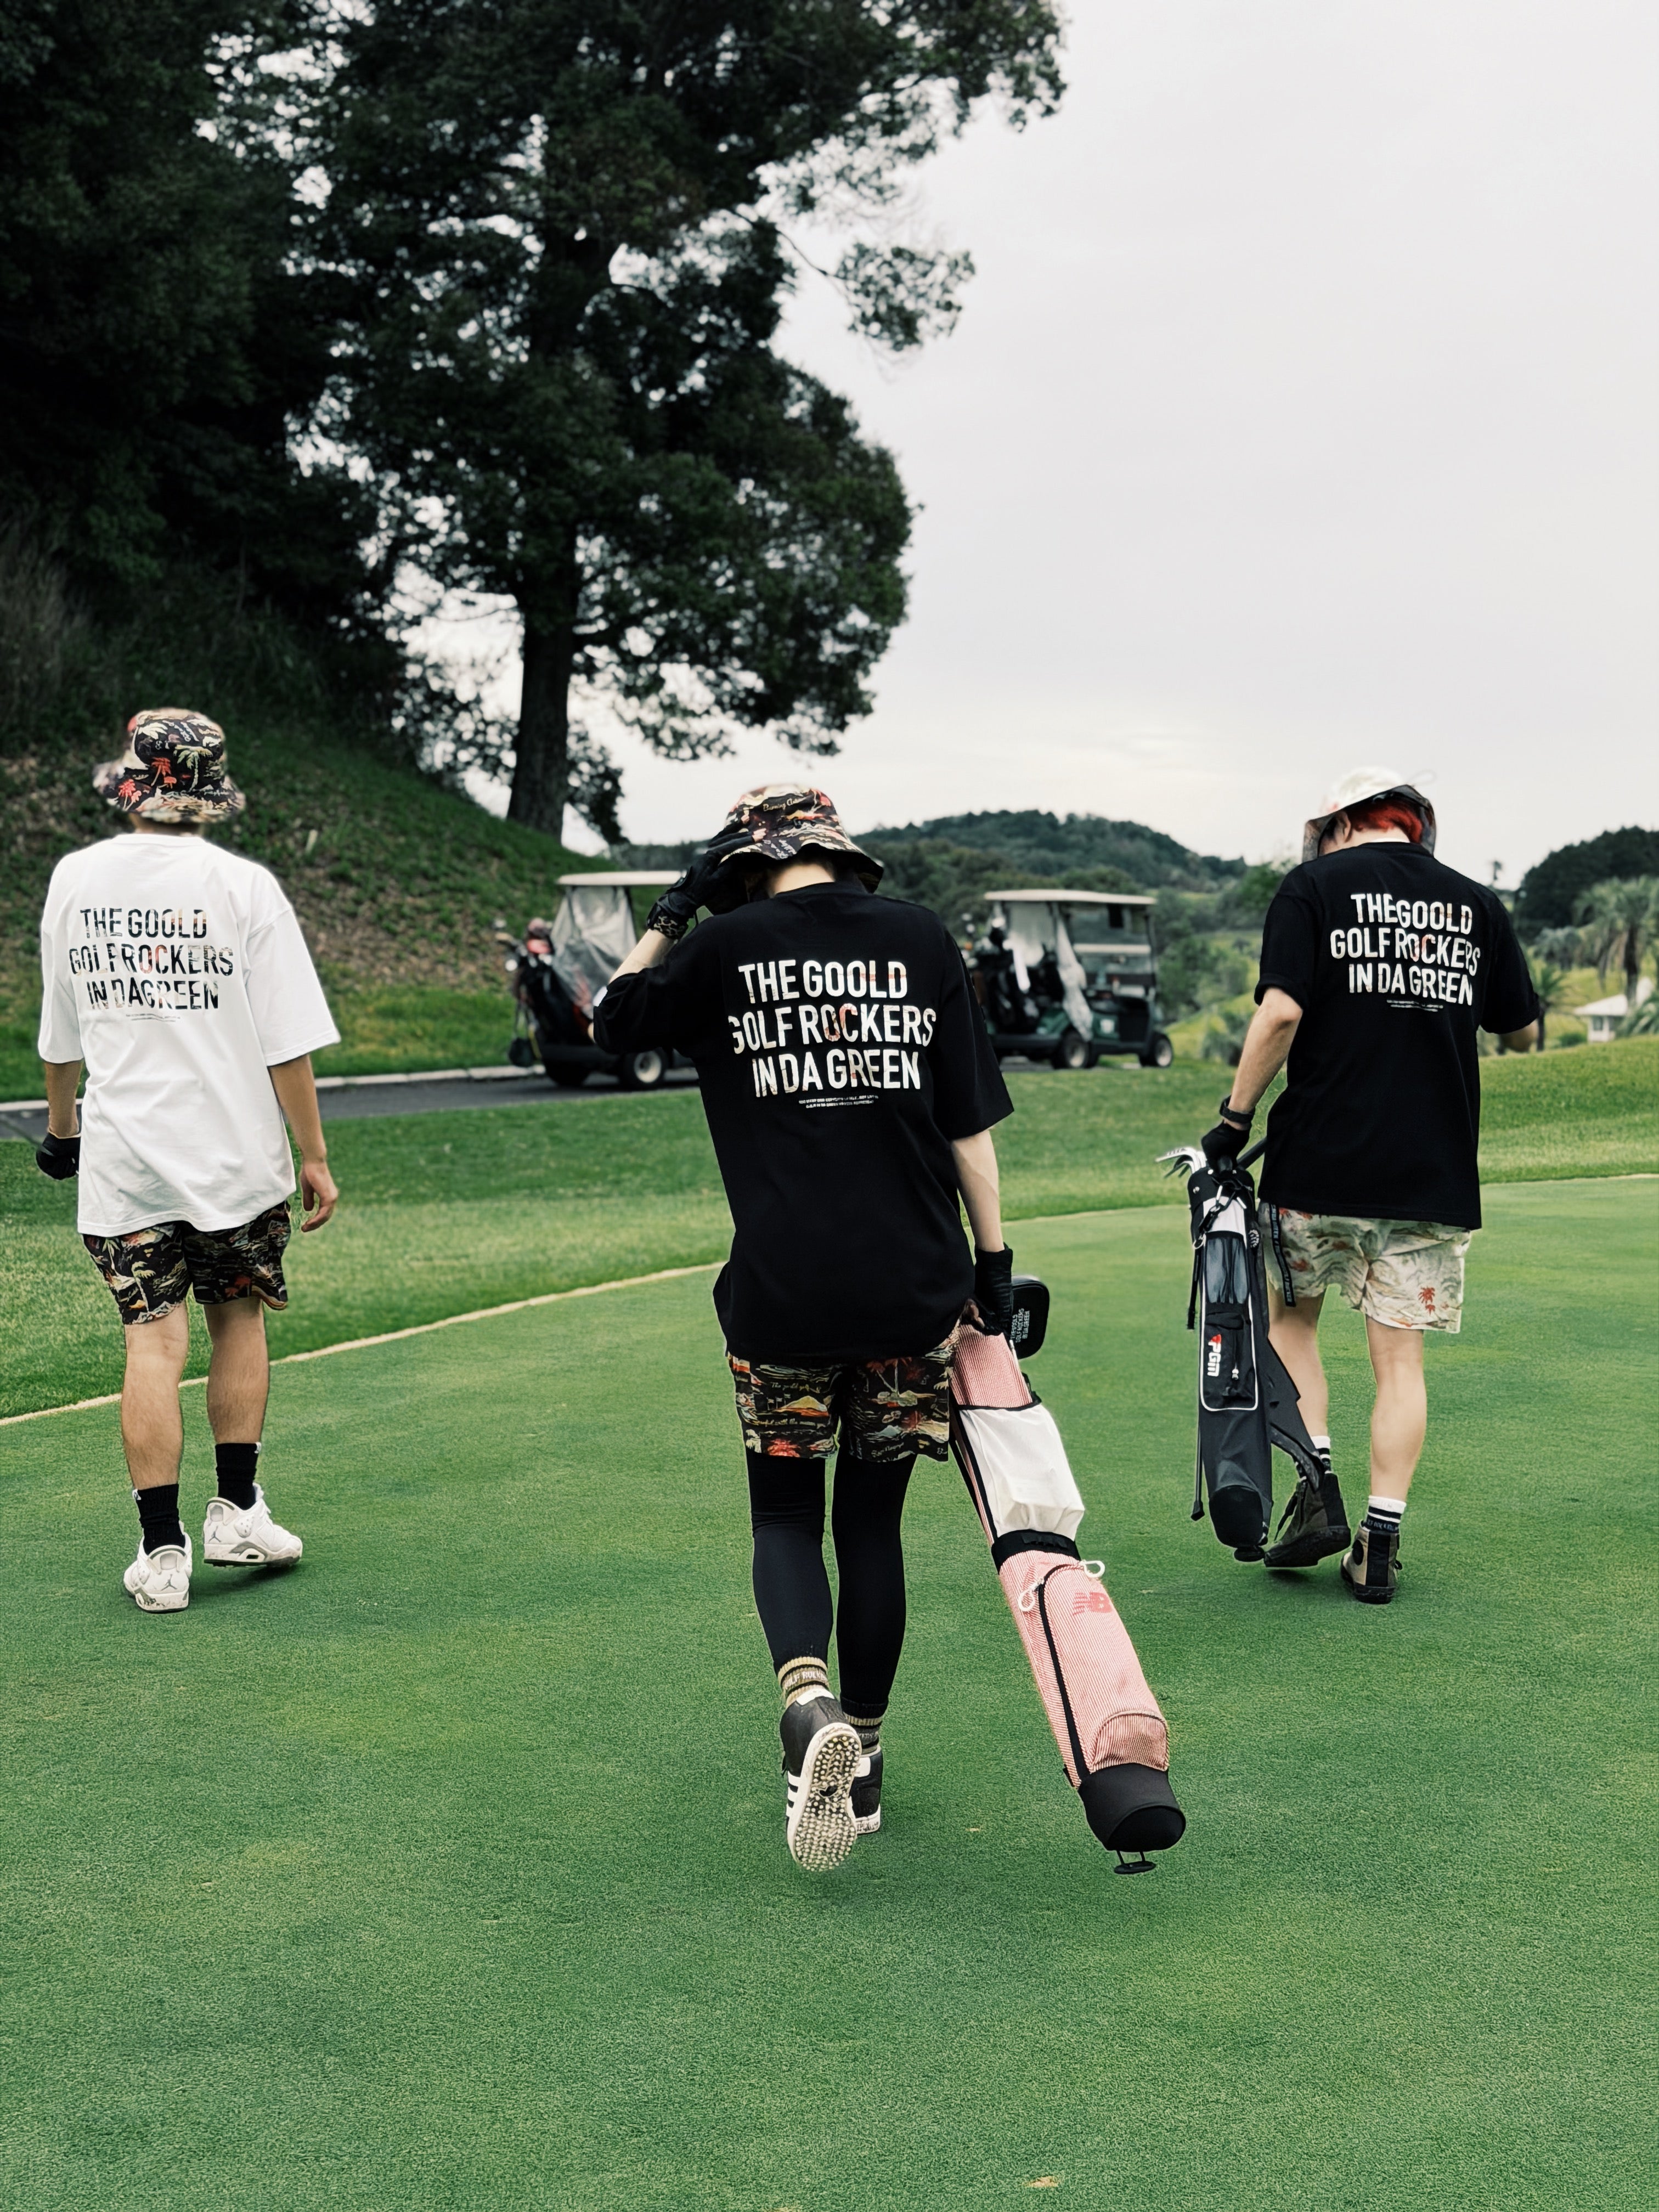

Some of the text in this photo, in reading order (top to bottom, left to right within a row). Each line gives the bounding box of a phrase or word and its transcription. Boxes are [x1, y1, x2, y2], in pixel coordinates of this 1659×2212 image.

[80, 907, 207, 939] THE GOOLD
[1350, 893, 1473, 935] THE GOOLD
[69, 943, 234, 977] GOLF ROCKERS
[1330, 927, 1481, 977] GOLF ROCKERS
[86, 976, 218, 1010] IN DA GREEN
[738, 959, 908, 1004] THE GOOLD
[1348, 962, 1473, 1006] IN DA GREEN
[727, 1003, 936, 1054] GOLF ROCKERS
[752, 1048, 921, 1098] IN DA GREEN
